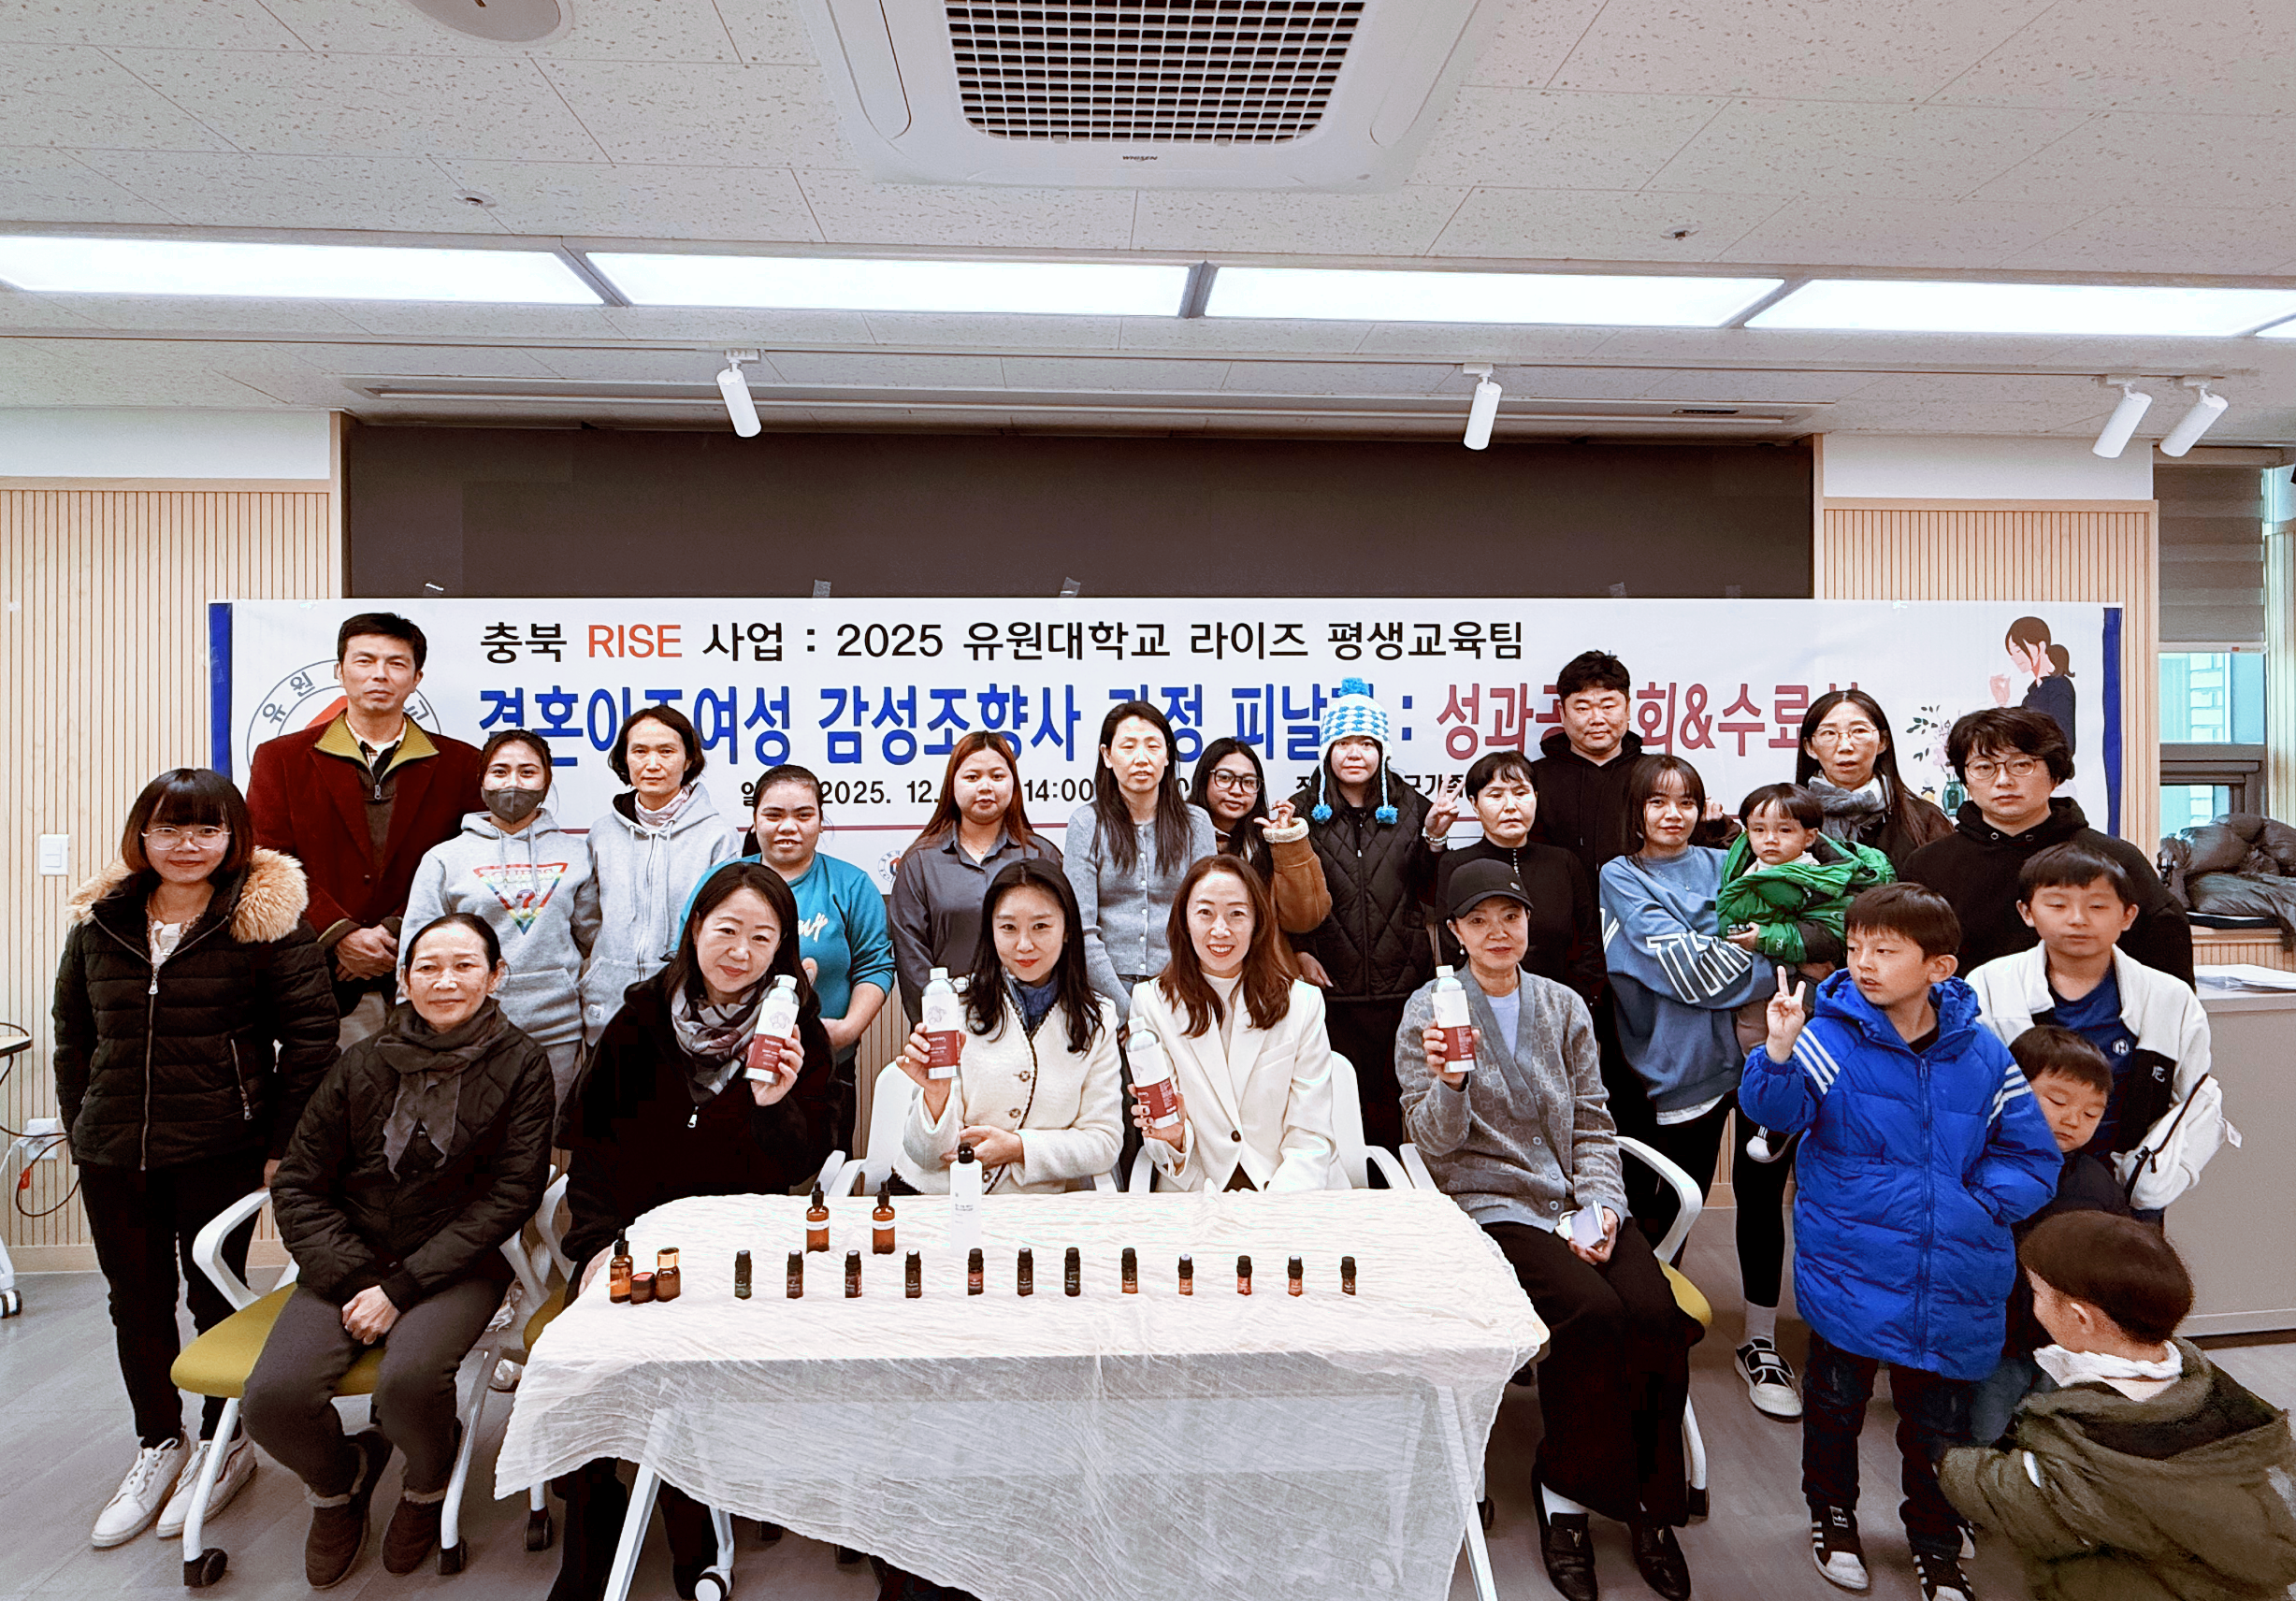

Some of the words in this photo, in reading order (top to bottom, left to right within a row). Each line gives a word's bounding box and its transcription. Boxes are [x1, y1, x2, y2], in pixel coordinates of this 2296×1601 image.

[481, 622, 568, 664] 충북
[588, 625, 683, 657] RISE
[702, 622, 782, 662] 사업
[806, 628, 816, 652] :
[837, 623, 944, 657] 2025
[963, 621, 1171, 661] 유원대학교
[1190, 621, 1308, 661] 라이즈
[1327, 620, 1522, 661] 평생교육팀
[478, 685, 791, 767] 결혼이여성
[818, 683, 1081, 766] 감성조향사
[1231, 683, 1374, 761] 피날
[1402, 695, 1413, 741] :
